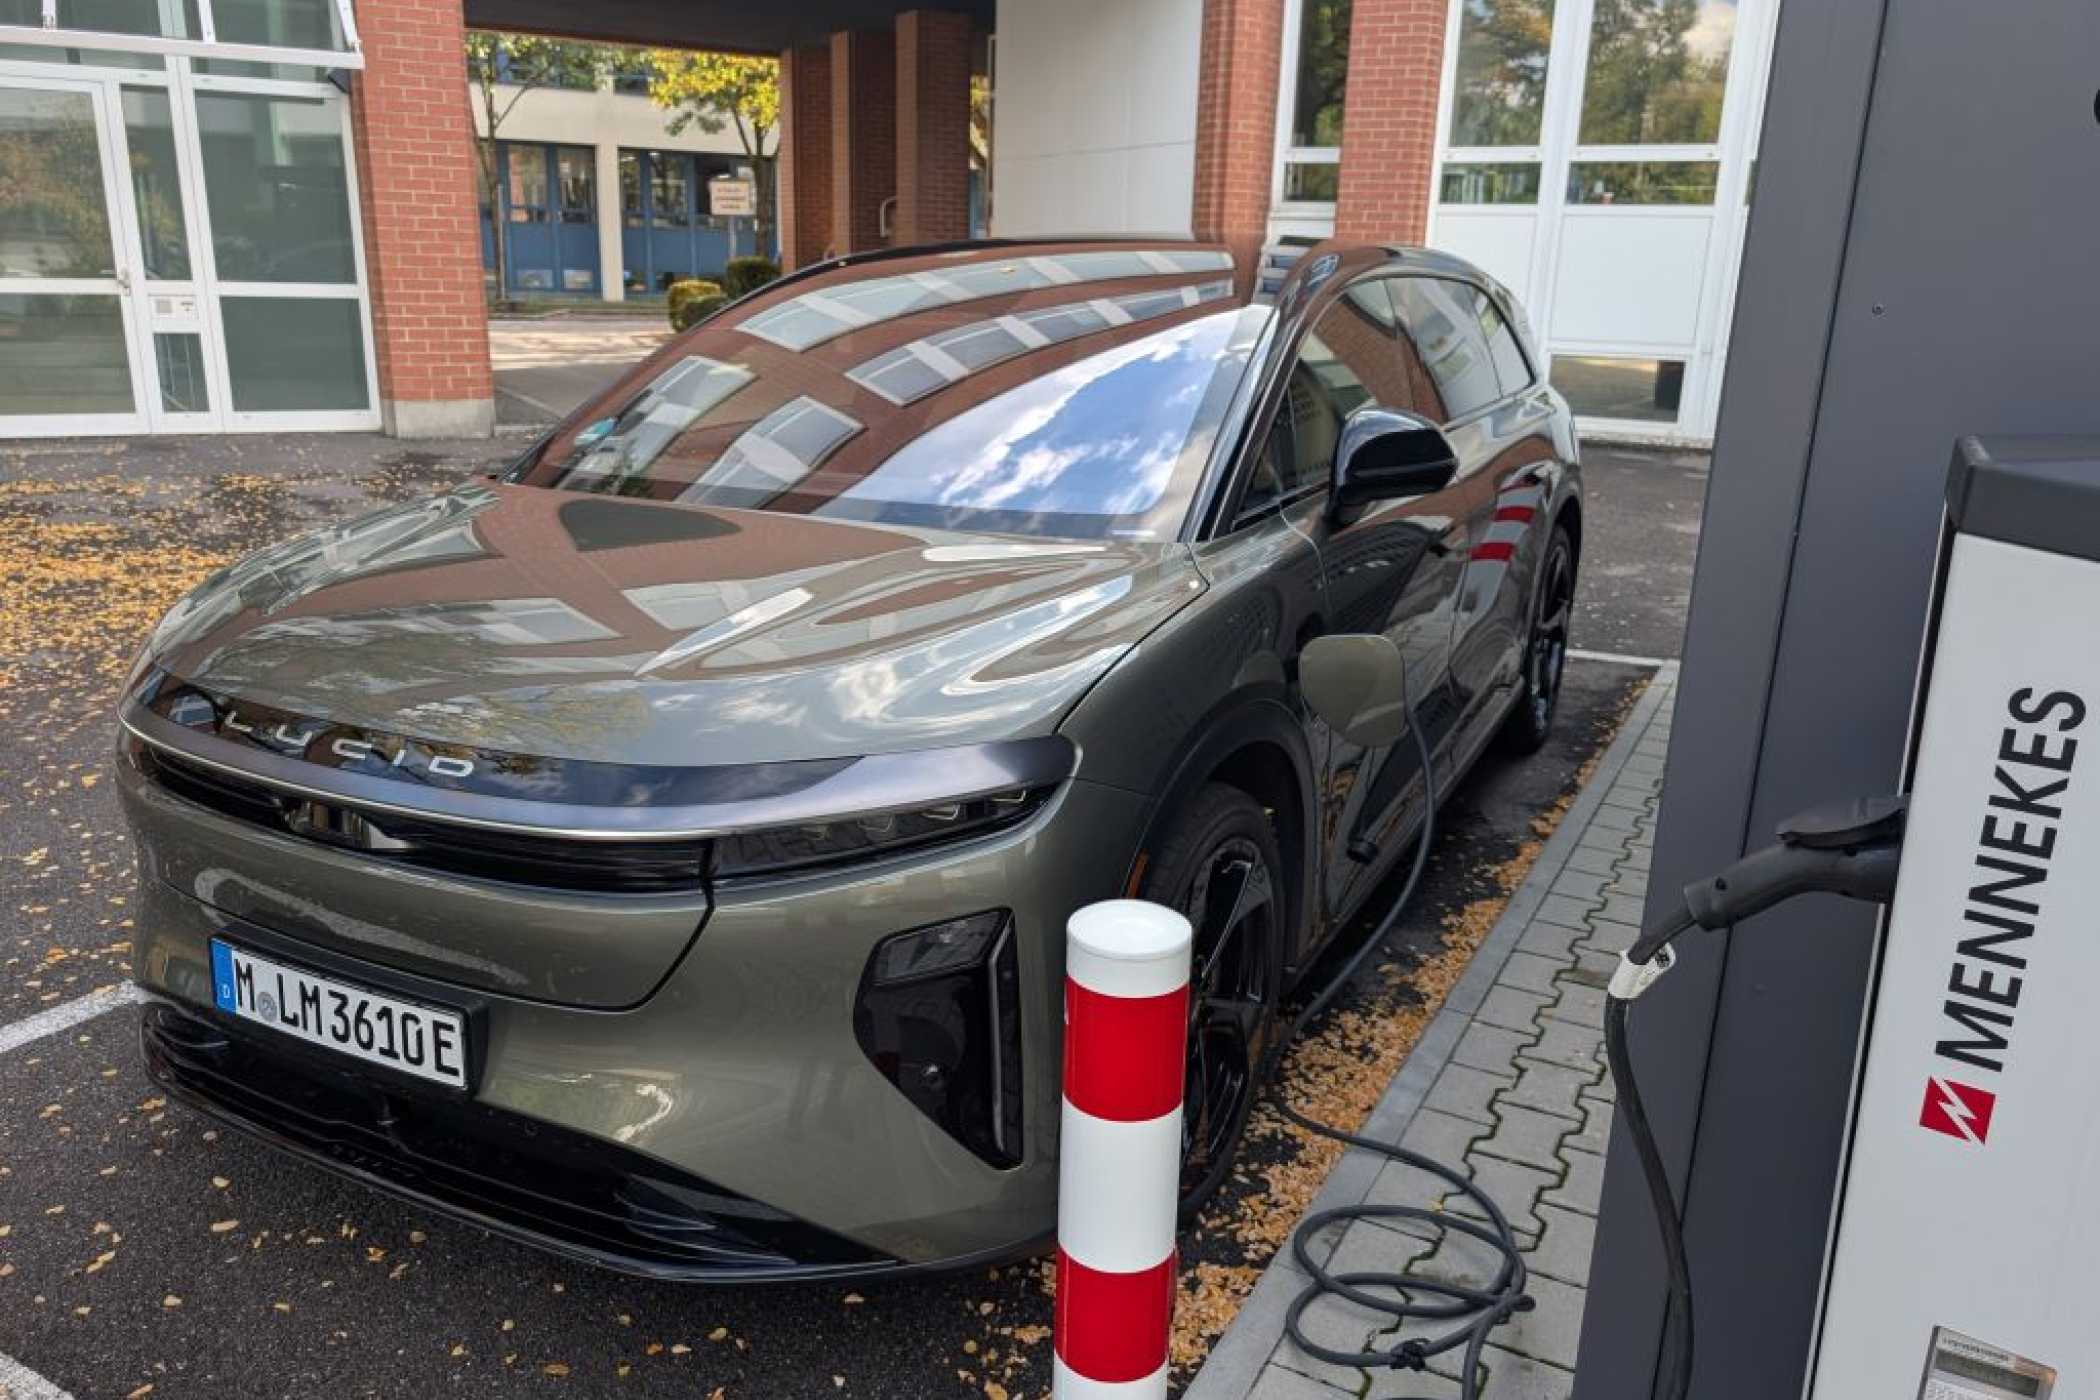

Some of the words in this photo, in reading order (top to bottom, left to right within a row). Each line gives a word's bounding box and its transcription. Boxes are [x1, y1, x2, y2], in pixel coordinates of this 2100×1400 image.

[224, 711, 475, 778] LUCID
[1935, 687, 2086, 1073] MENNEKES
[234, 958, 255, 1012] M
